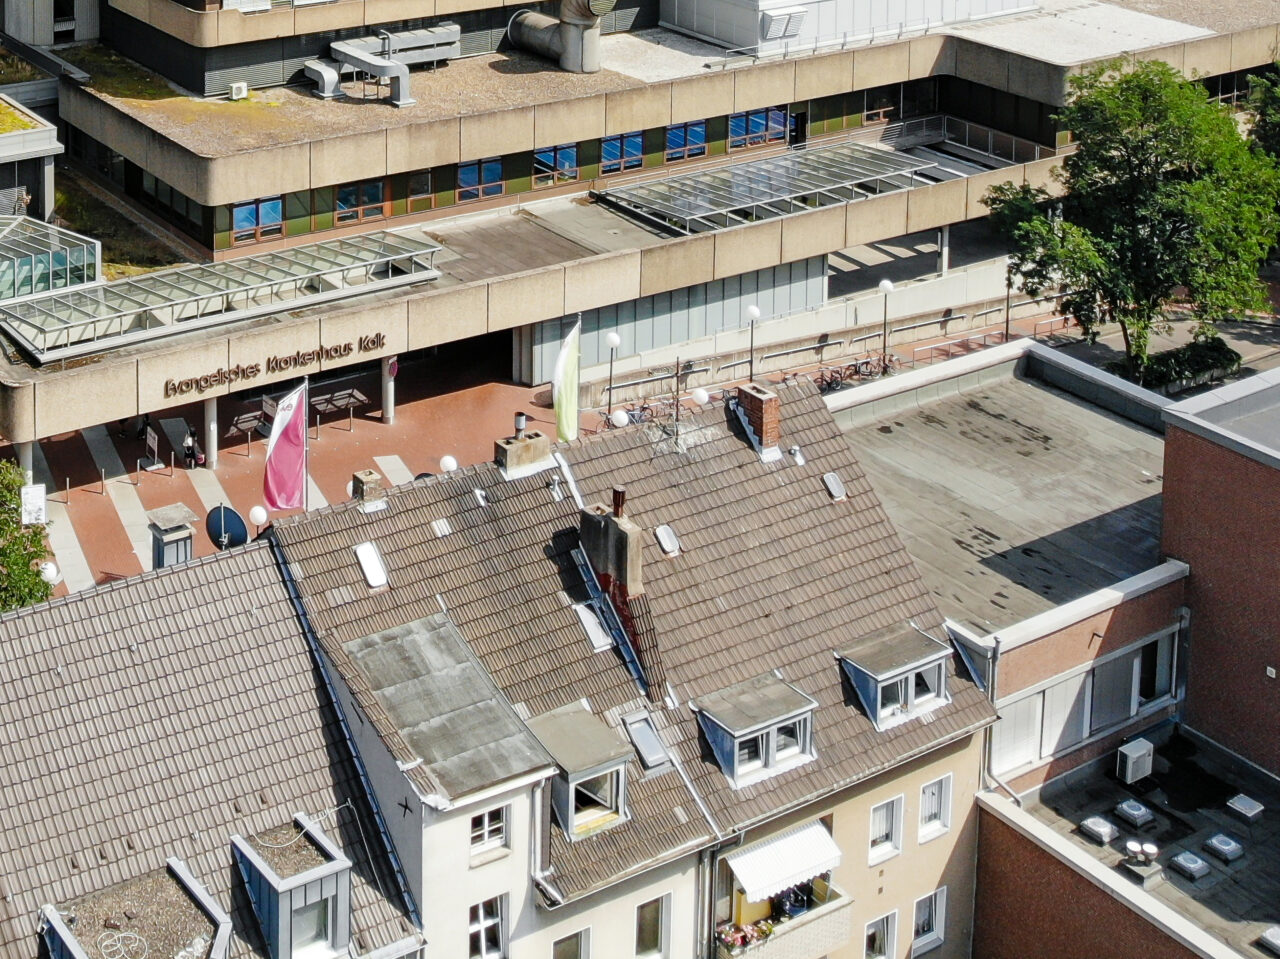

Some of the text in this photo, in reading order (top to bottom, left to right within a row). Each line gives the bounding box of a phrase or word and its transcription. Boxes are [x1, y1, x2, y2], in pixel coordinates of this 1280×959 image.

[164, 332, 386, 398] Evangelisches Krankenhaus Kalk
